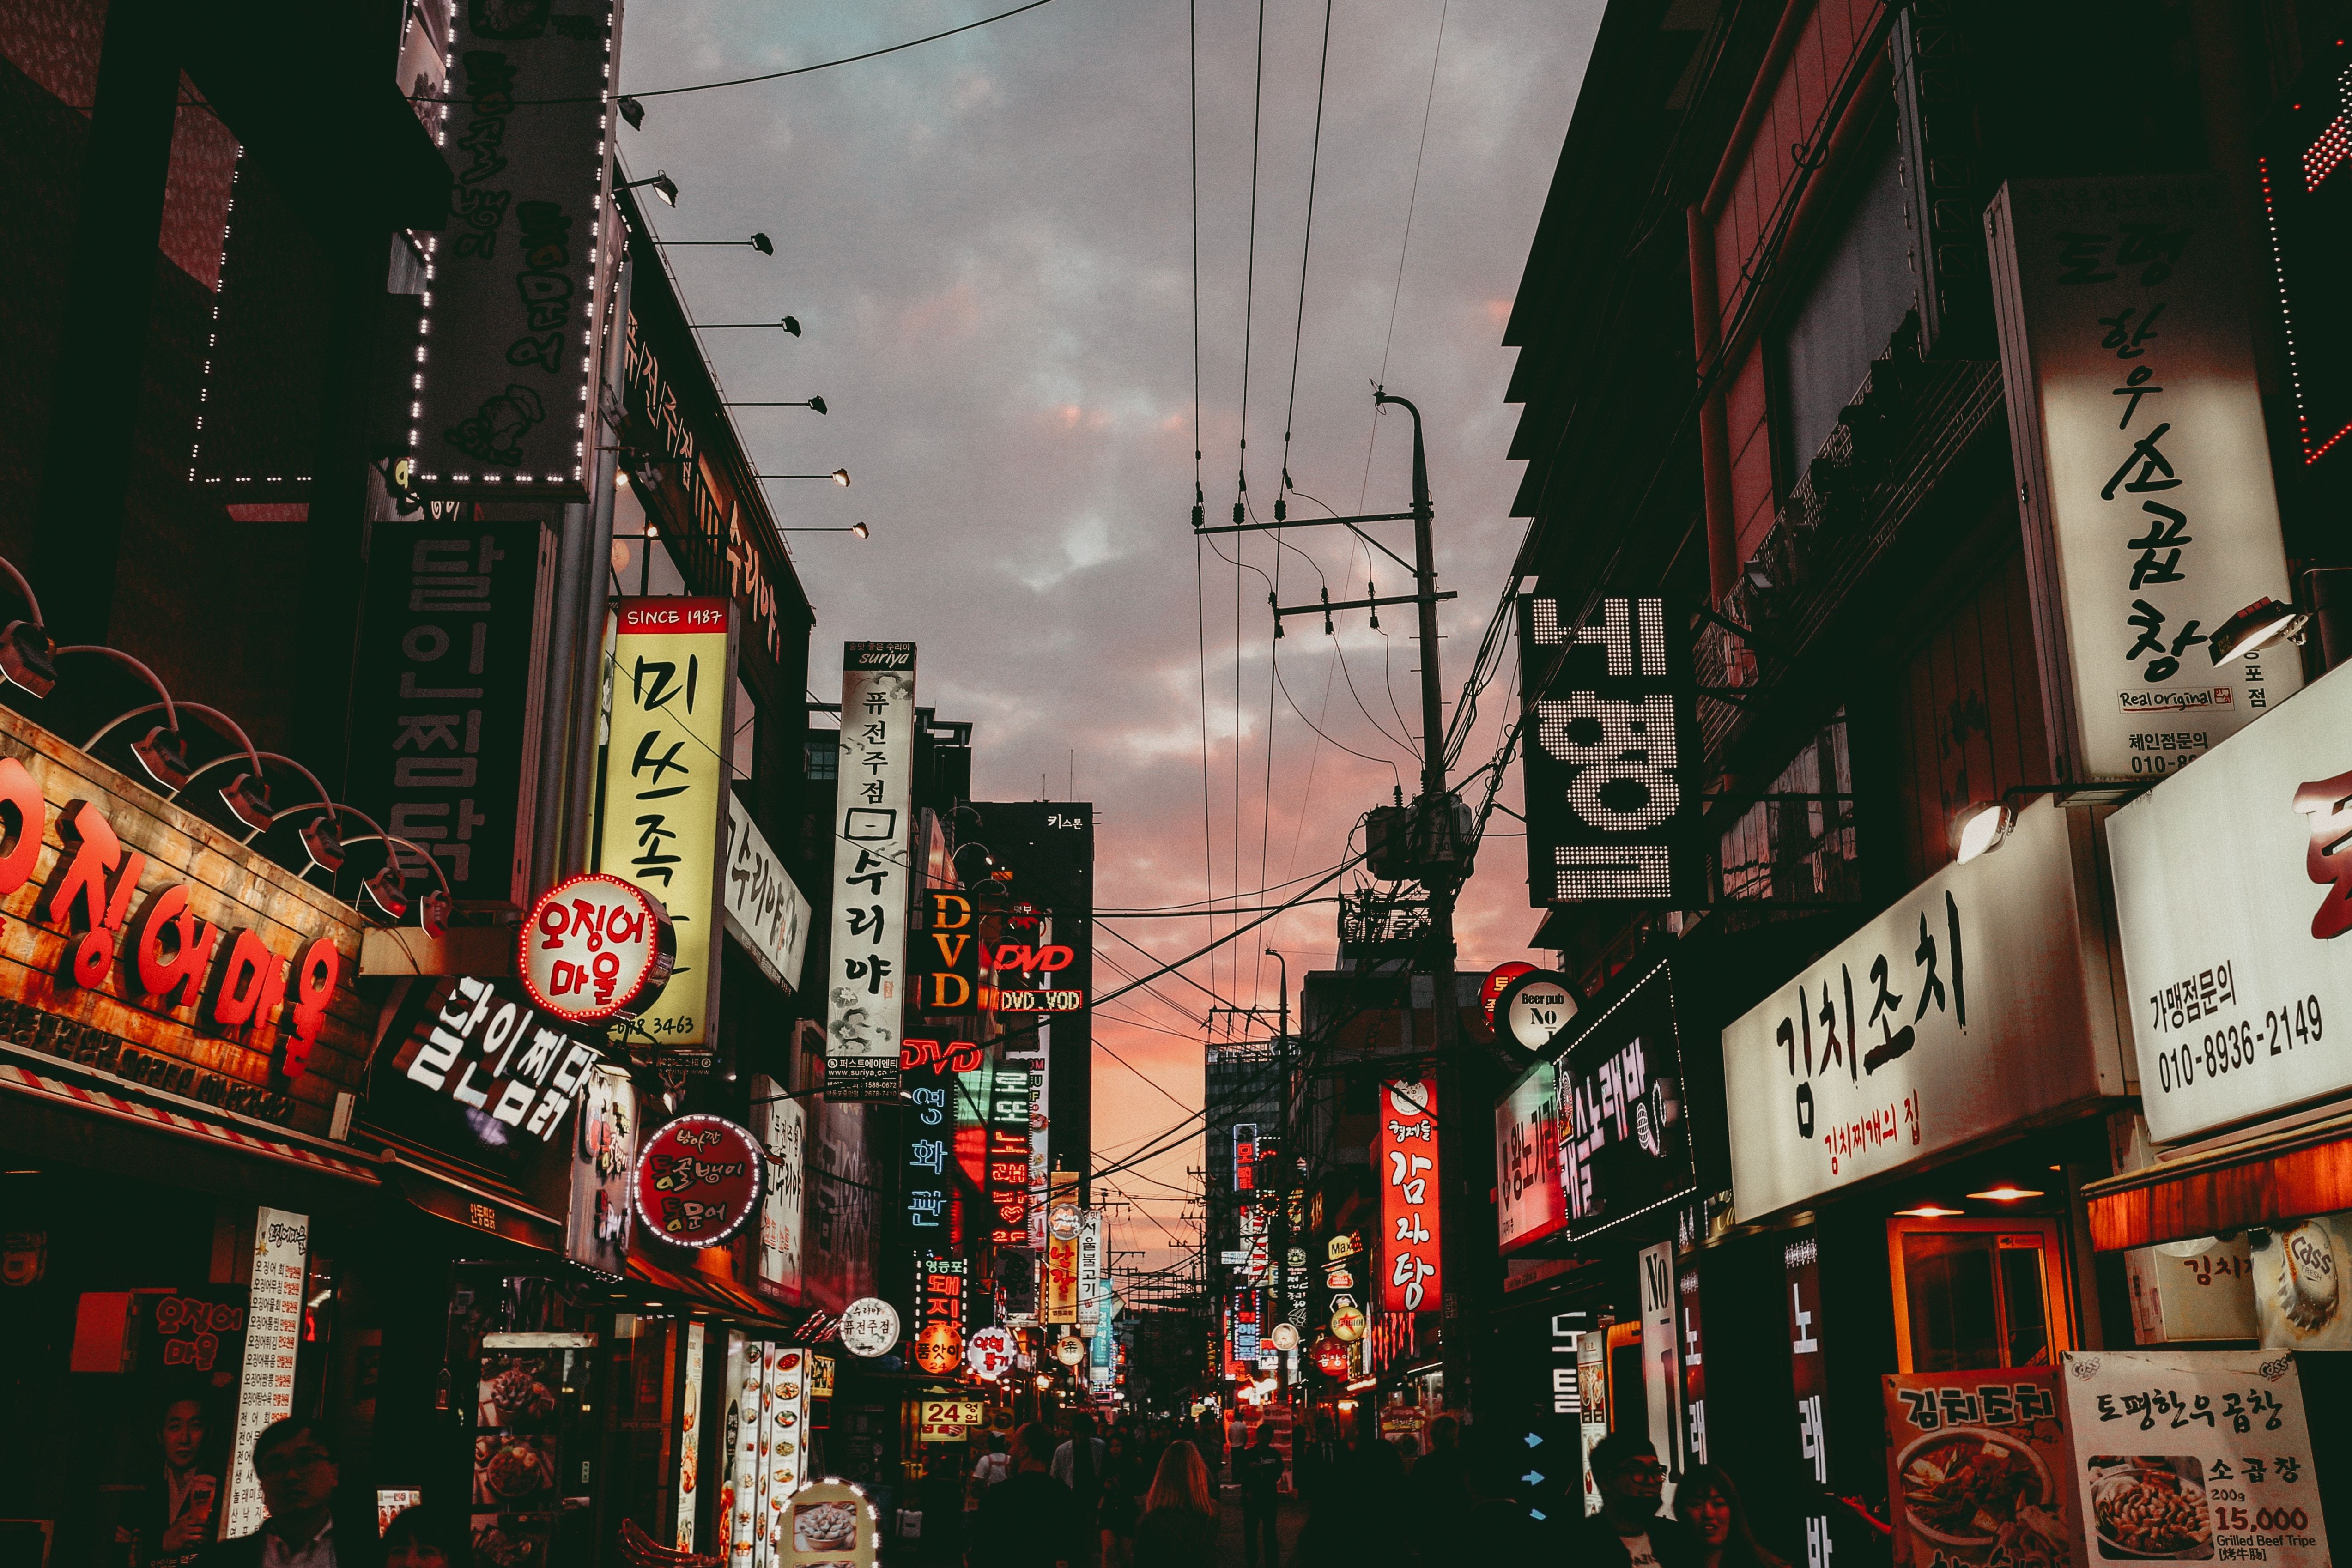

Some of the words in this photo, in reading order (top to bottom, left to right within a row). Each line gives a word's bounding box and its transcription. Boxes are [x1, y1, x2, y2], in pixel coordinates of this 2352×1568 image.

[2100, 422, 2208, 682] 소곱창
[627, 610, 679, 624] SINCE
[687, 609, 723, 625] 1987
[858, 650, 910, 668] suriya
[886, 642, 910, 651] 수리야
[385, 535, 506, 881] 달인찜닭
[2120, 692, 2151, 707] Real
[860, 690, 890, 805] 퓨전주점
[2128, 731, 2209, 751] 체인점문의
[1047, 814, 1083, 830] 키스톤
[732, 819, 787, 963] 수리야
[539, 899, 645, 952] 오징어
[844, 849, 892, 994] 수리야
[931, 894, 971, 1008] DVD
[992, 944, 1074, 971] DVD
[549, 952, 619, 1005] 마을
[1522, 993, 1545, 1005] Beer
[1546, 993, 1564, 1005] pub
[2150, 959, 2237, 1034] 가맹점문의
[654, 1015, 695, 1035] 3463
[1776, 889, 1967, 1139] 김치조치
[901, 1039, 983, 1076] DVD
[2158, 994, 2323, 1094] 010-8936-2149
[406, 975, 600, 1142] 달인찜닭
[839, 1058, 898, 1069] 퍼스트에이엔티
[1388, 1120, 1432, 1142] 형제들
[1825, 1103, 1897, 1175] 김치찌개의
[1904, 1088, 1921, 1145] 집
[907, 1087, 948, 1227] 영화관
[1237, 1143, 1255, 1189] 모텔
[650, 1155, 744, 1193] 통골뱅이
[661, 1197, 727, 1234] 통문어
[268, 1223, 306, 1255] 오징어마을
[1389, 1150, 1436, 1312] 감자탕
[1331, 1242, 1351, 1256] Max
[926, 1260, 963, 1274] 영등포
[253, 1278, 283, 1294] 오징어무침
[156, 1297, 243, 1335] 오징어
[251, 1297, 281, 1313] 오징어물회
[853, 1306, 881, 1316] 수리야
[926, 1275, 963, 1331] 돼지
[844, 1319, 890, 1335] 퓨전주점
[164, 1333, 220, 1372] 마을
[974, 1335, 1004, 1353] 인형
[245, 1353, 276, 1368] 오징어볶음
[983, 1352, 1010, 1371] 뽑기
[928, 1403, 961, 1423] 24
[965, 1403, 979, 1424] 영업
[1897, 1382, 2057, 1434] 김치조치
[236, 1449, 251, 1465] 전어
[2209, 1456, 2301, 1483] 소곱창
[234, 1469, 254, 1485] 생새
[2211, 1489, 2247, 1504] 200g
[2215, 1506, 2309, 1533] 15,000
[2217, 1534, 2255, 1547] Grilled
[2257, 1534, 2284, 1547] Beef
[2285, 1534, 2316, 1550] Tripe
